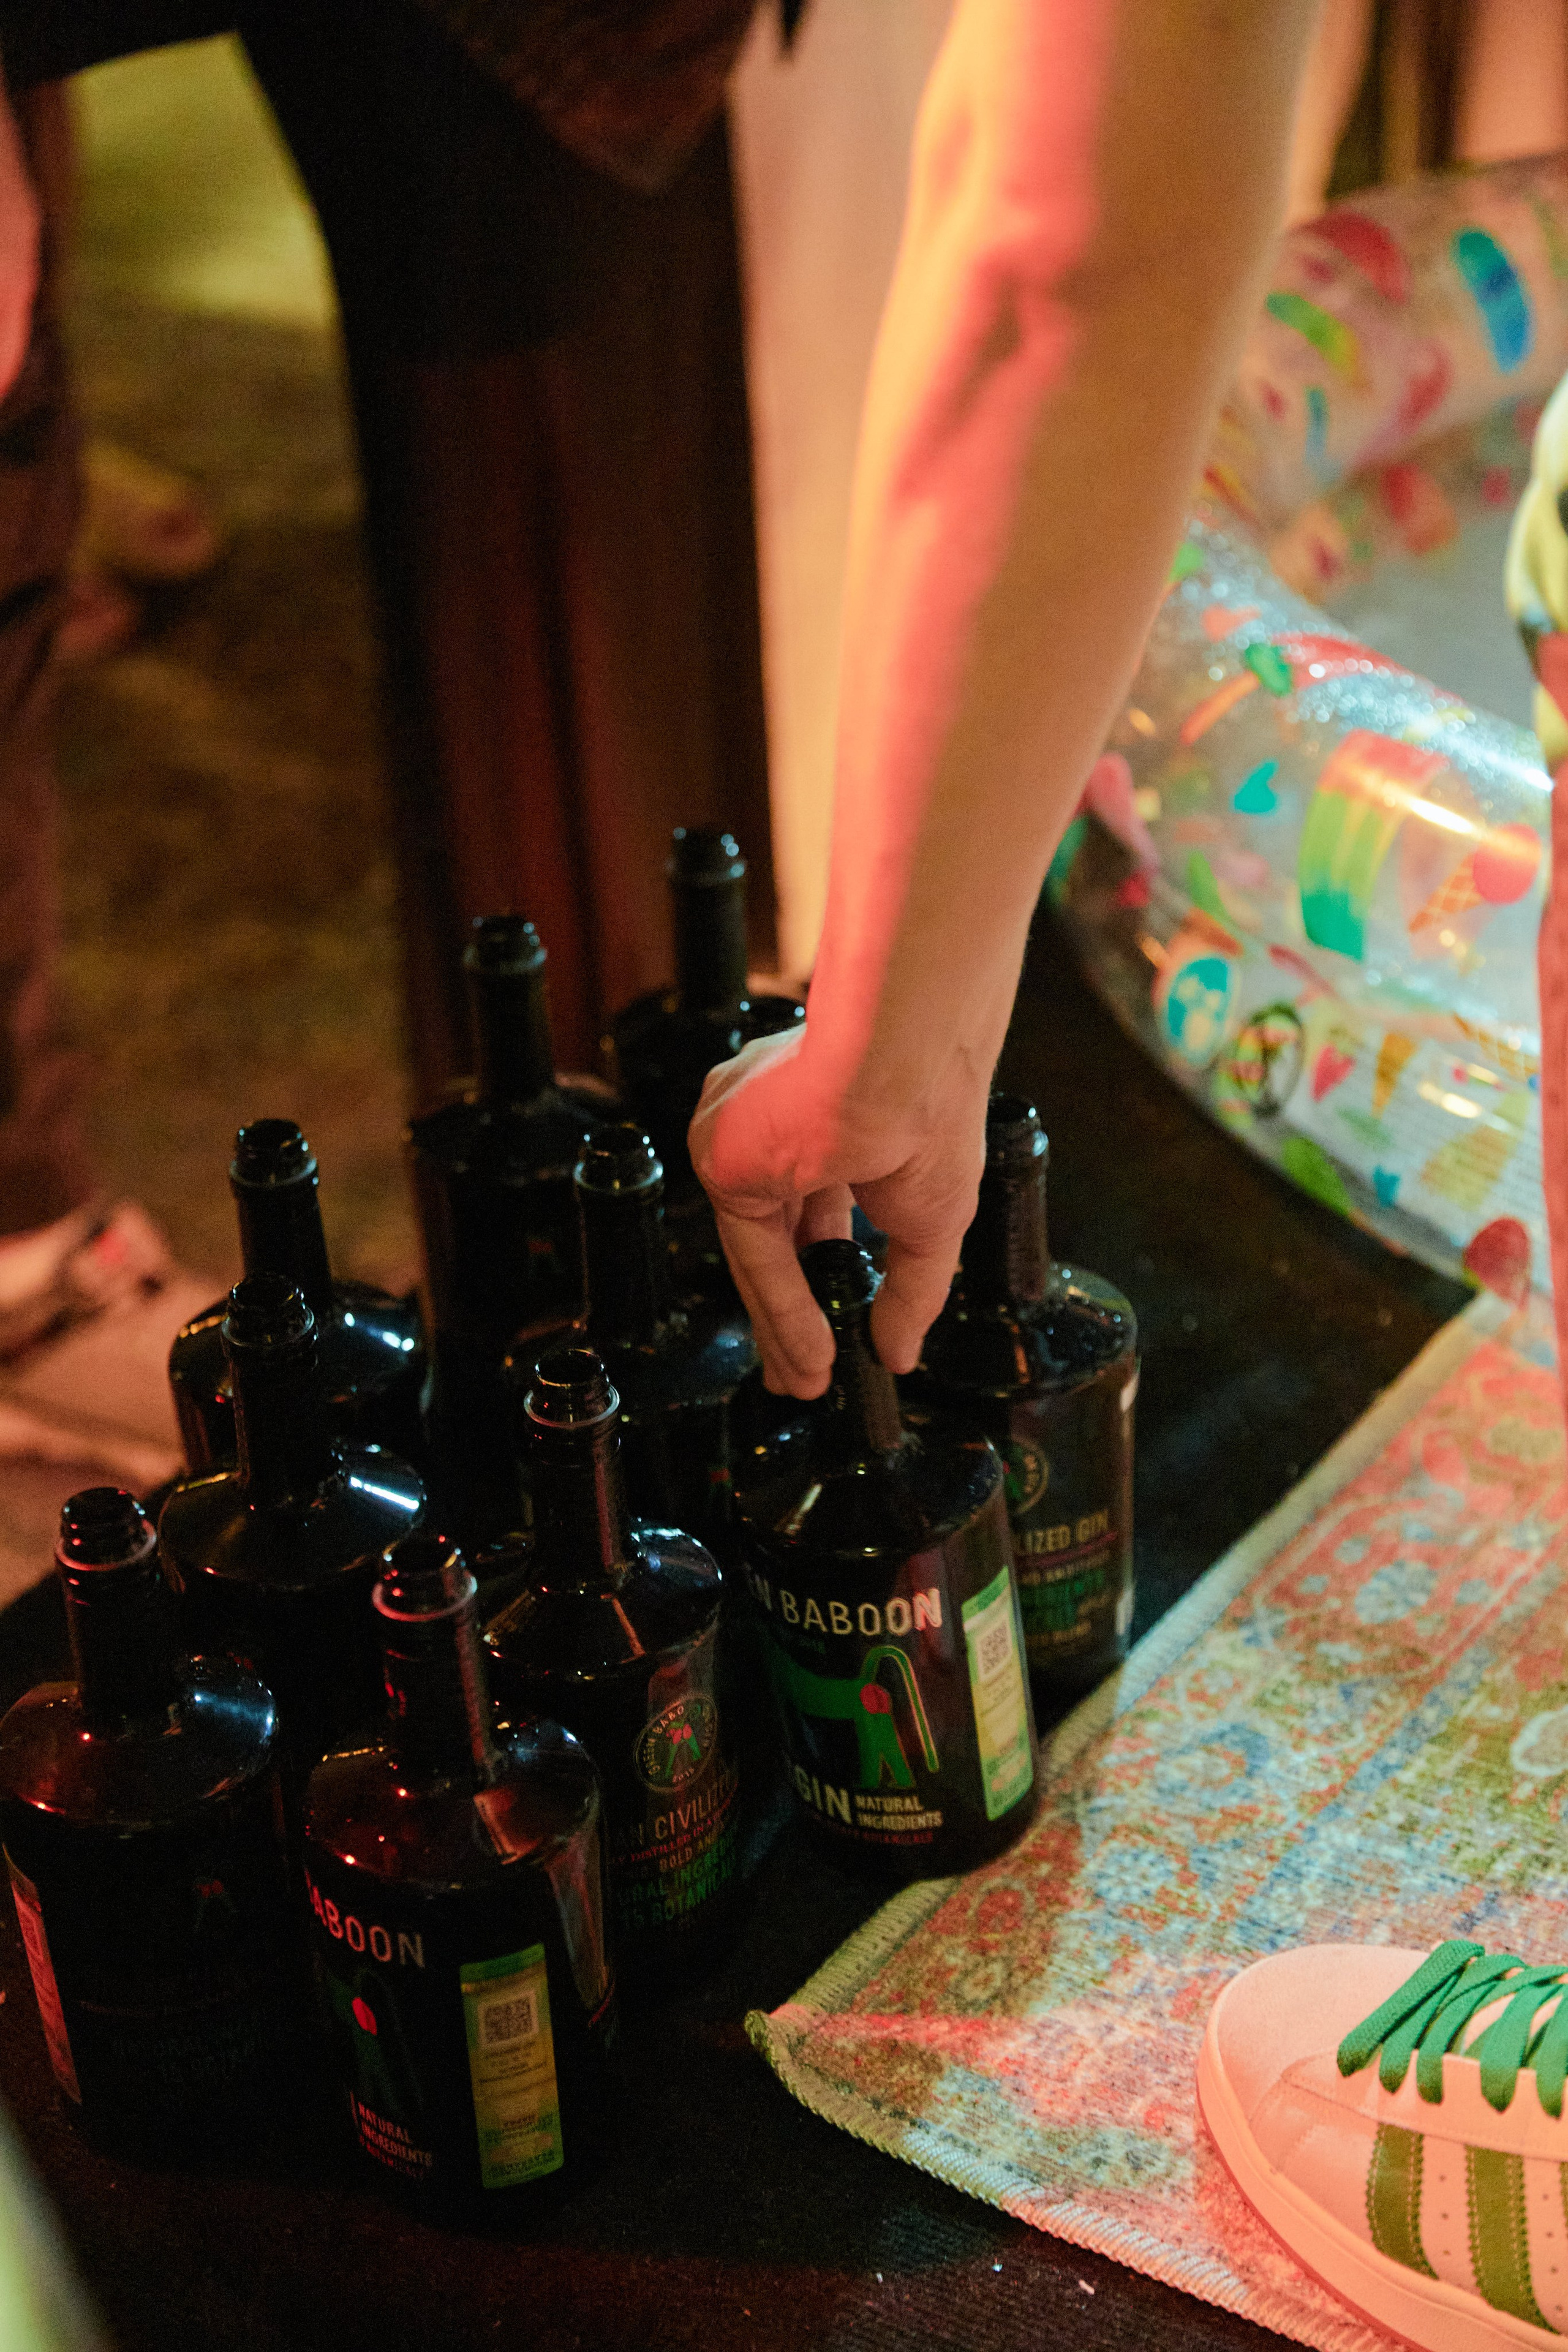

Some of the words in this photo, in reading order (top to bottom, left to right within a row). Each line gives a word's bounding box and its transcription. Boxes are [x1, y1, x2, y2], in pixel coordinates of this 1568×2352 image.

[778, 1588, 943, 1636] BABOON
[794, 1764, 853, 1825] GIN
[854, 1795, 924, 1812] NATURAL
[856, 1810, 944, 1831] INGREDIENTS
[658, 1846, 694, 1874] BOLD
